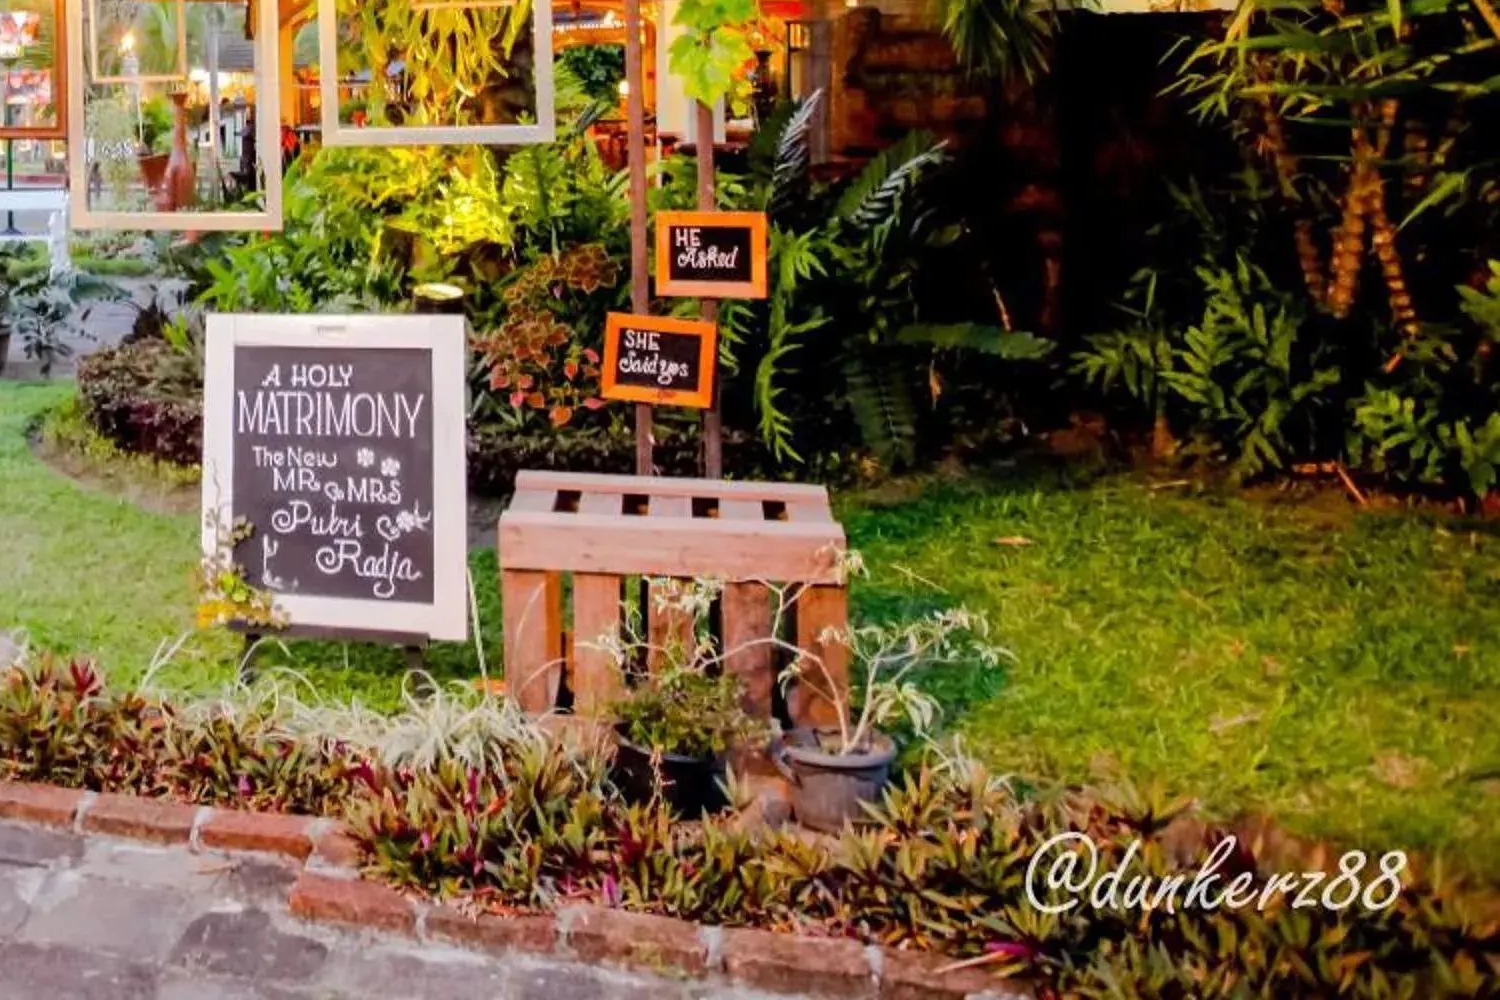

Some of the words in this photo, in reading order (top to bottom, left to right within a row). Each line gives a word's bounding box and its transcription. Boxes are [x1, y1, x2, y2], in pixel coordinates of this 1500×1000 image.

[674, 228, 702, 248] HE
[677, 246, 740, 270] Asked
[623, 329, 662, 351] SHE
[618, 350, 660, 375] Said
[261, 363, 282, 388] A
[290, 363, 354, 388] HOLY
[236, 388, 425, 438] MATRIMONY
[252, 445, 285, 468] The
[286, 445, 338, 468] New
[315, 538, 425, 599] Radja
